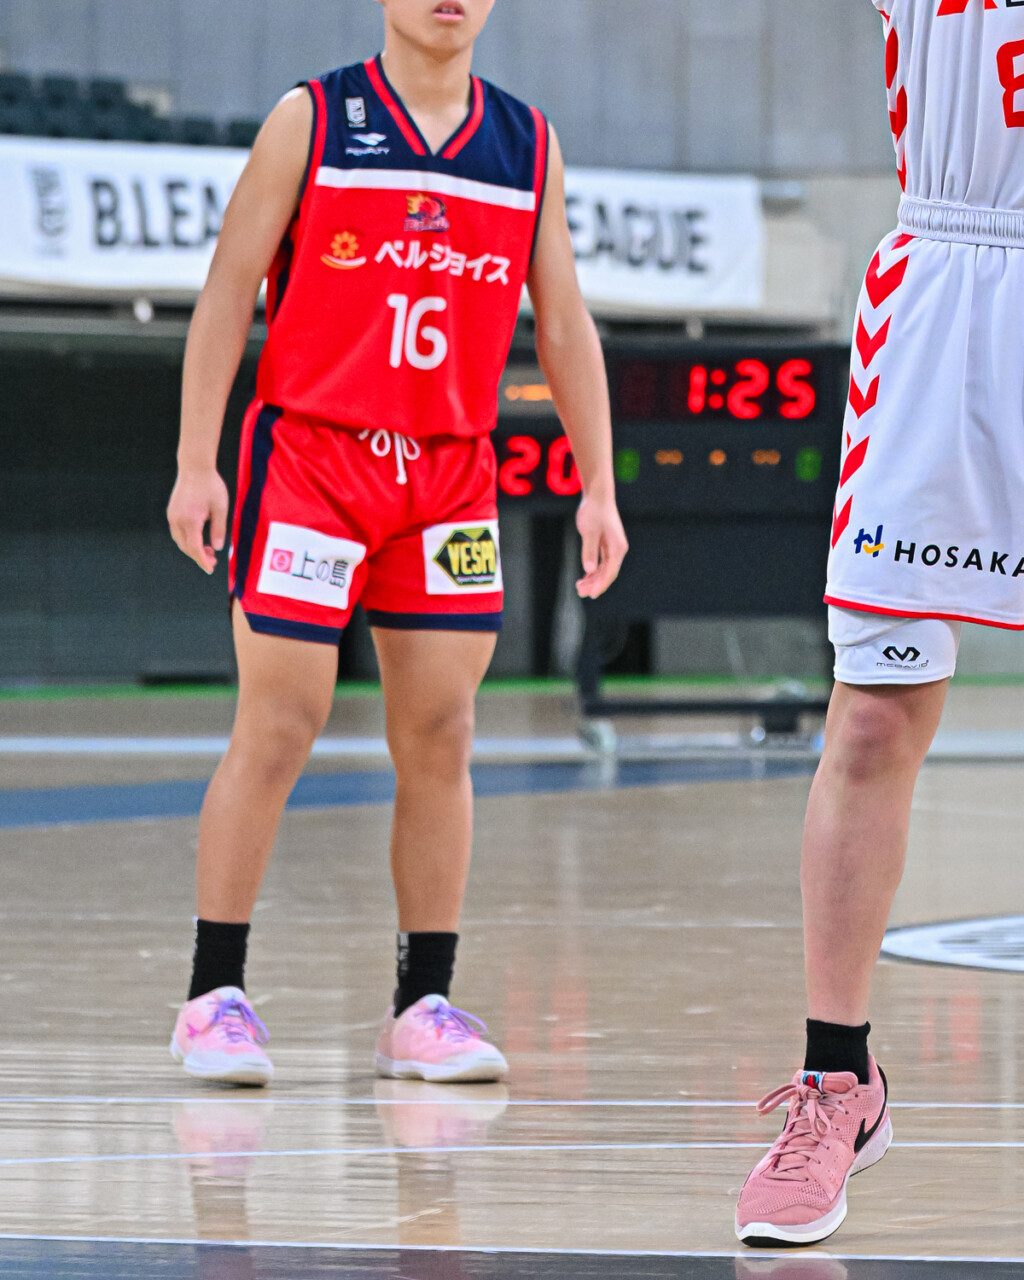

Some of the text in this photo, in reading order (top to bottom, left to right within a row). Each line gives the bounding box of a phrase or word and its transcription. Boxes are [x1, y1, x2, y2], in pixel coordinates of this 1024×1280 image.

[374, 240, 511, 286] ベルジョイス
[387, 293, 448, 370] 16
[688, 358, 816, 420] 1:25
[499, 435, 583, 496] 20
